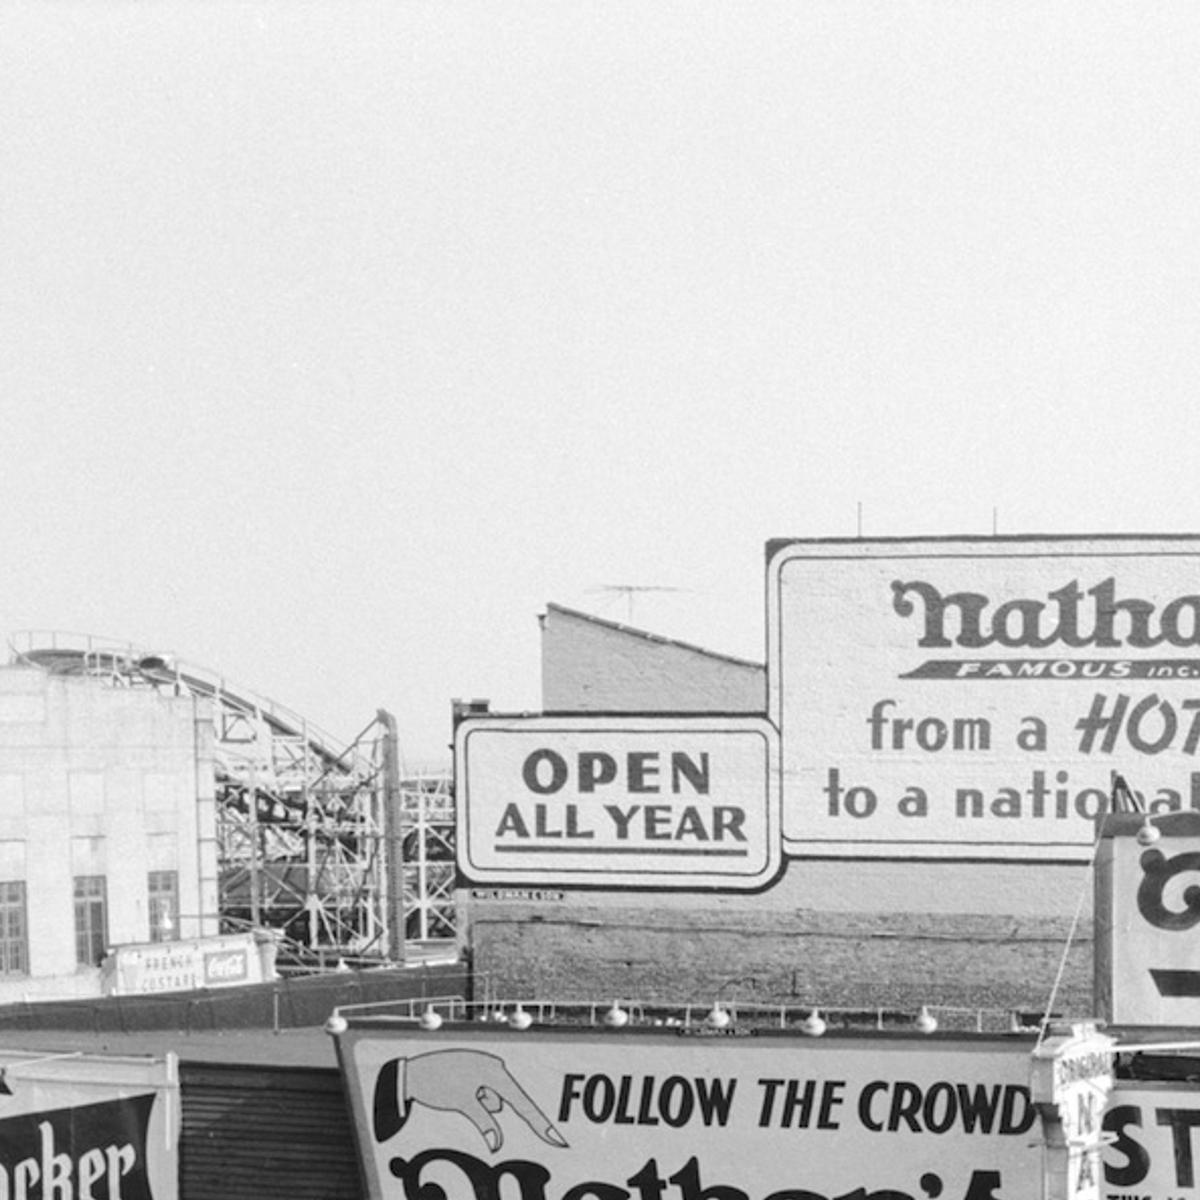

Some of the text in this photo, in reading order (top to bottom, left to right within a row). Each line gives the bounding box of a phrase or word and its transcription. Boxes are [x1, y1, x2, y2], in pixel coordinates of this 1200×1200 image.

[955, 659, 1132, 677] FAMOUS
[866, 699, 992, 752] from
[1016, 716, 1048, 752] a
[521, 748, 710, 795] OPEN
[822, 768, 877, 818] to
[896, 786, 929, 818] a
[494, 803, 749, 842] ALL YEAR
[557, 1074, 1037, 1136] FOLLOW THE CROWD
